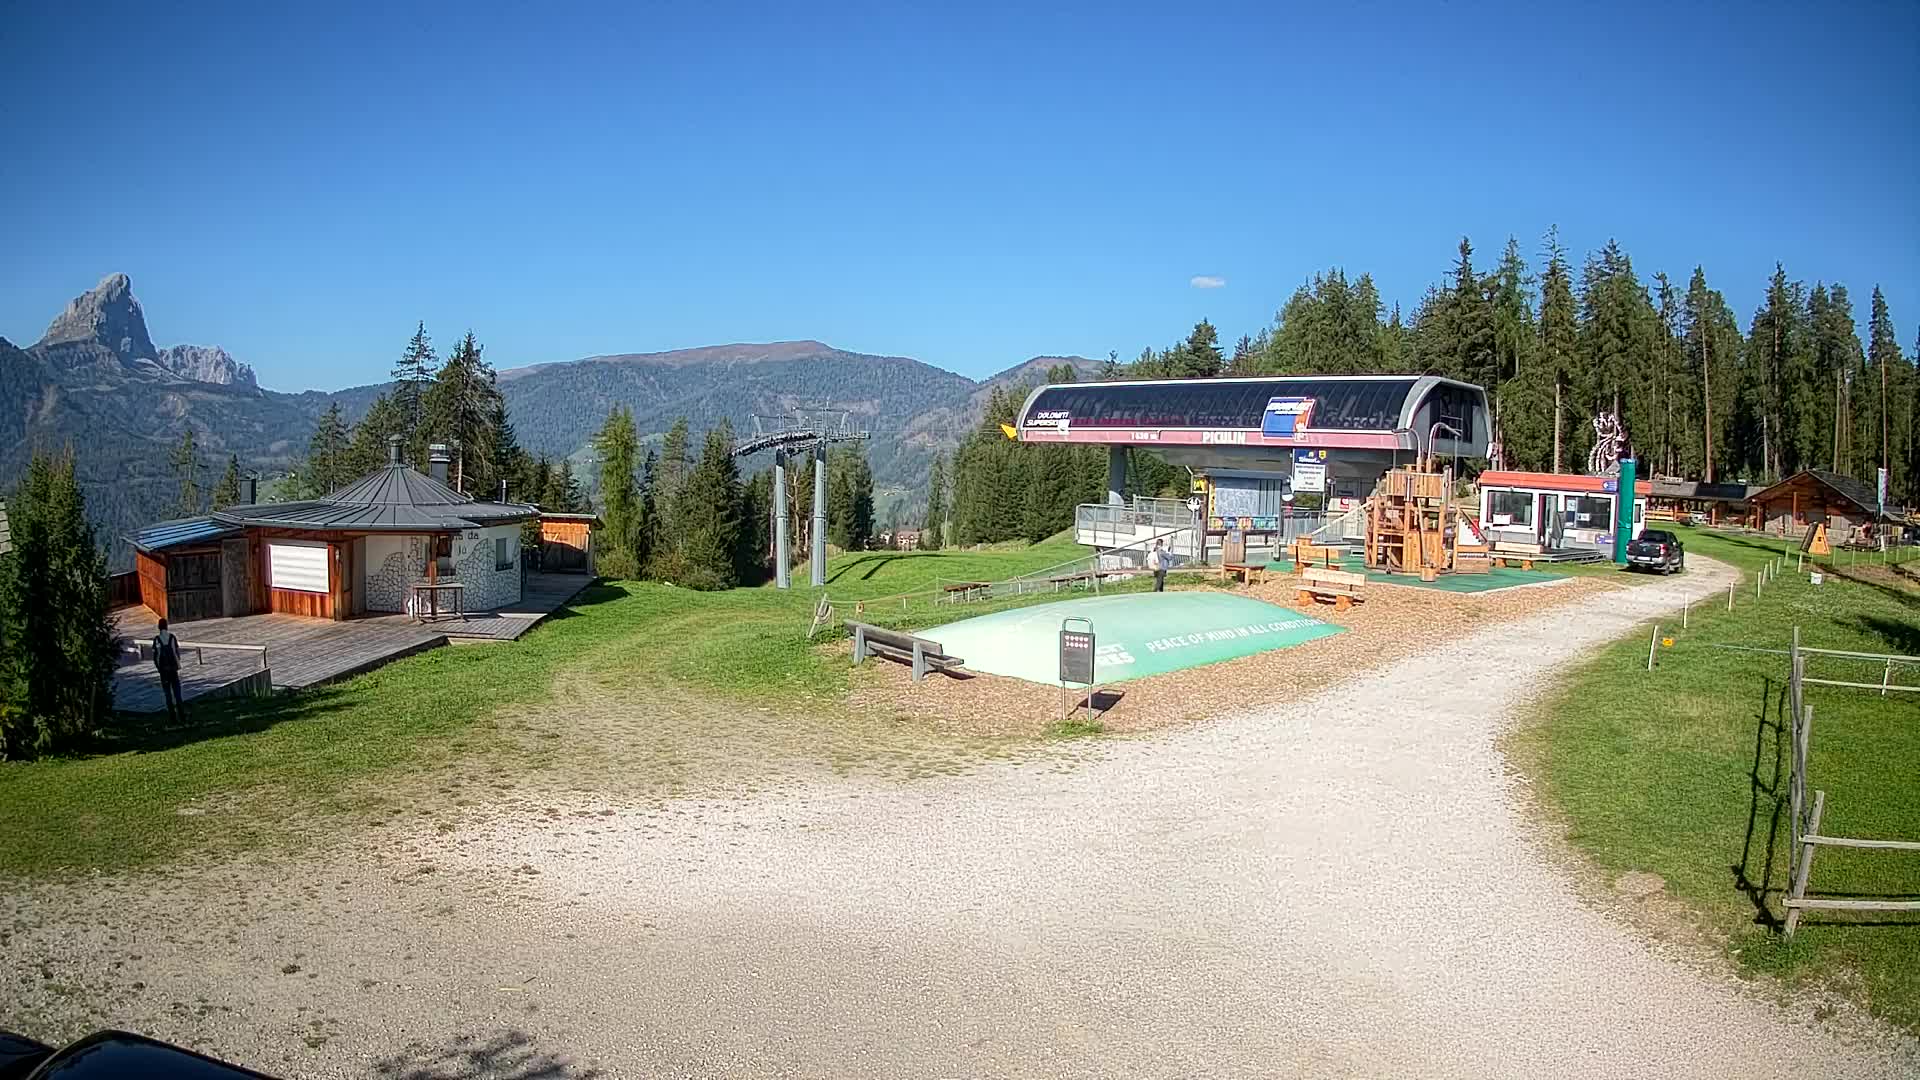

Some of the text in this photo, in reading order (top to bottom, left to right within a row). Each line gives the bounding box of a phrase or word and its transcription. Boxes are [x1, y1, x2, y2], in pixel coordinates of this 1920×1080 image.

[1202, 431, 1246, 444] PICULIN
[1145, 636, 1188, 653] PEACE
[1187, 632, 1207, 645] OF
[1205, 628, 1236, 642] MIND
[1233, 627, 1249, 639] IN
[1249, 624, 1270, 635] ALL
